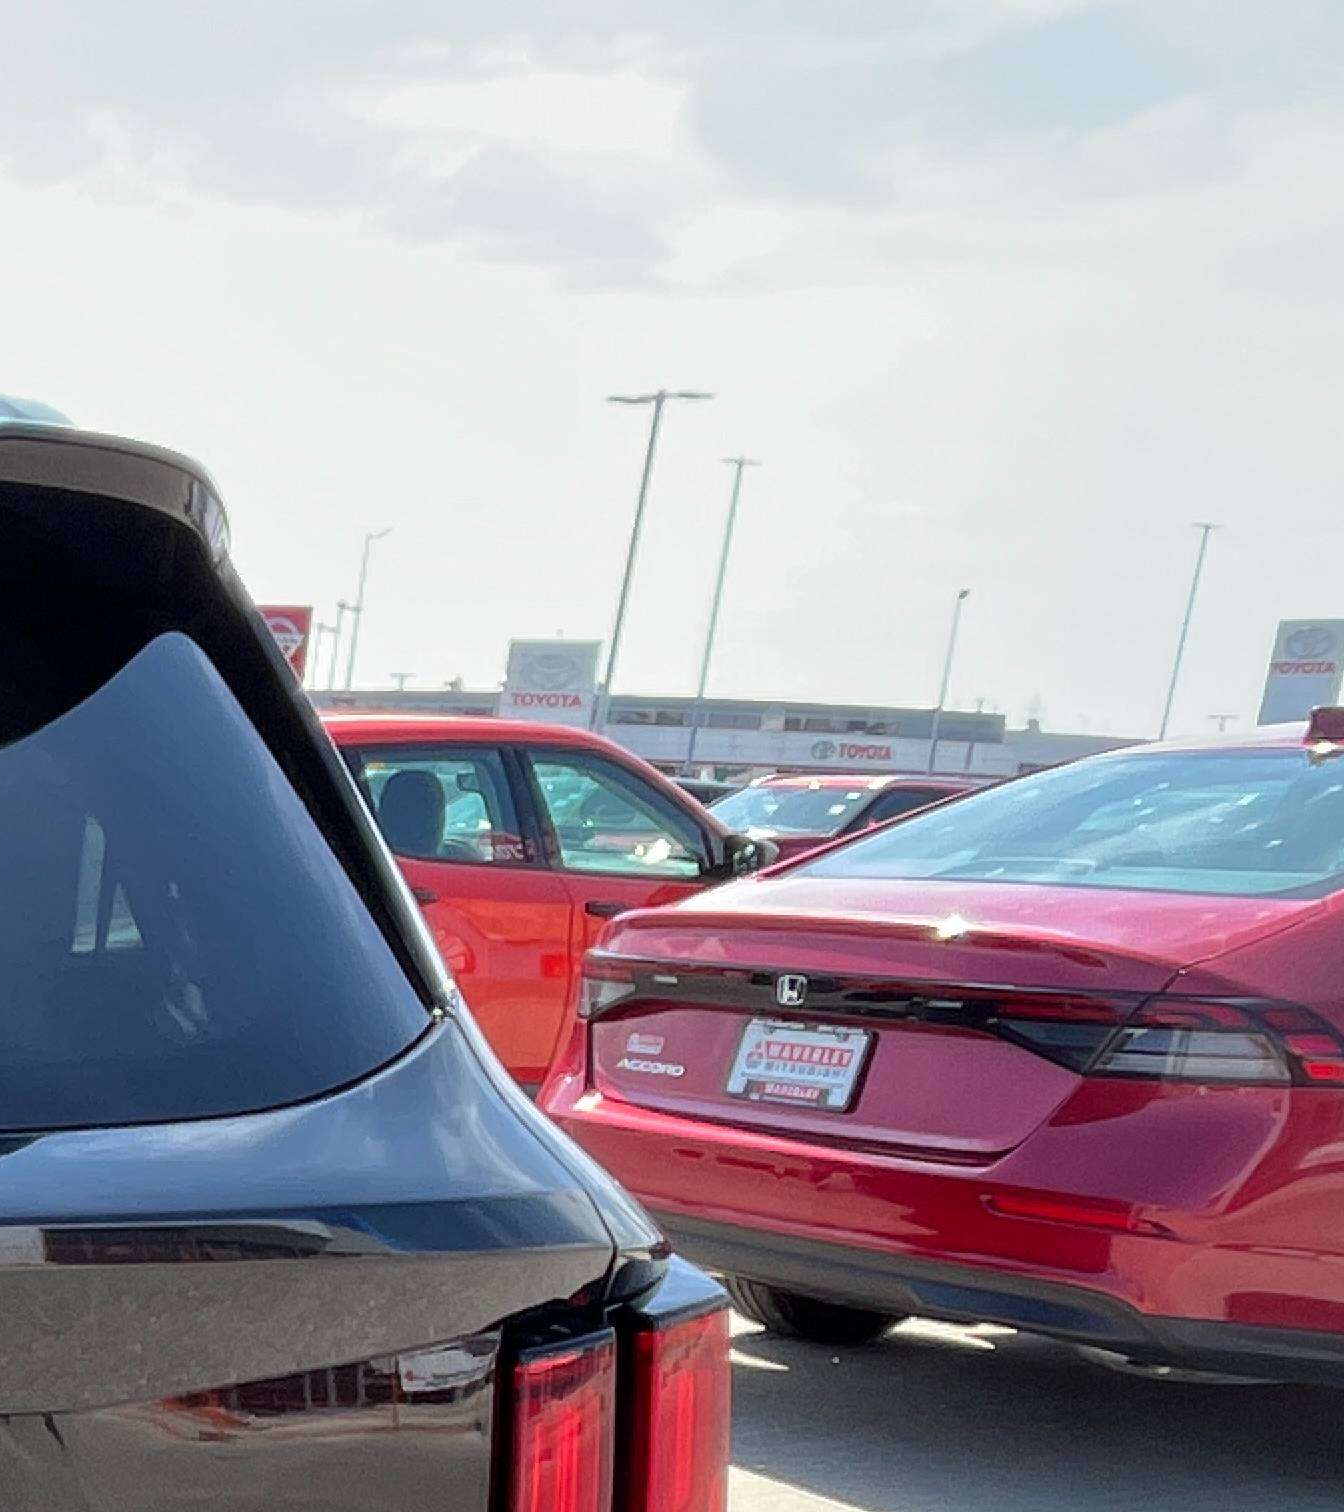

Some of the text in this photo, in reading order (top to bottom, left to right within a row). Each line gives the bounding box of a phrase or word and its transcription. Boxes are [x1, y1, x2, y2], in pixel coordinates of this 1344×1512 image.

[1271, 661, 1336, 674] TOYOTA
[513, 692, 582, 708] TOYOTA
[839, 743, 891, 759] TOYOTA
[616, 1058, 686, 1076] ACCORD
